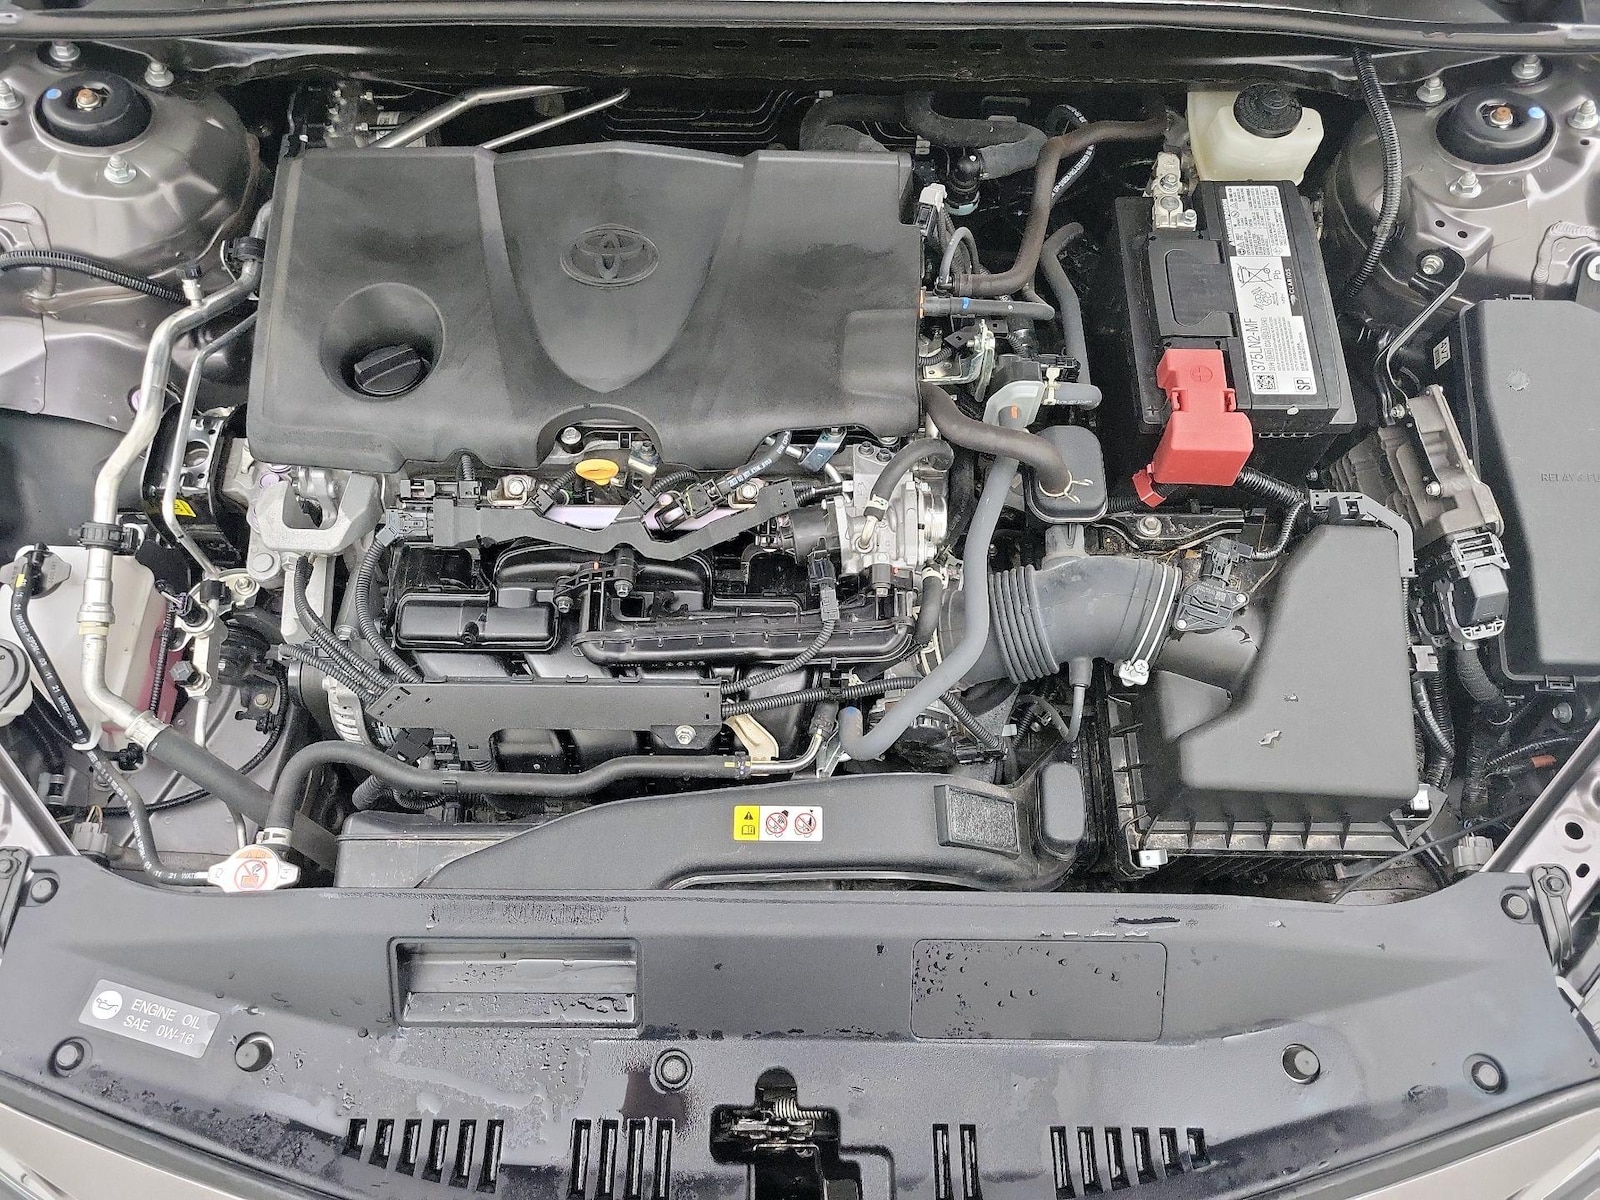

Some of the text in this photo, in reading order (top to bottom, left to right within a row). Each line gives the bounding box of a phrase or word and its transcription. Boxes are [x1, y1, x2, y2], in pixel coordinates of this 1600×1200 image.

[1273, 270, 1281, 280] Pb
[1284, 268, 1295, 294] CLARIOS
[1244, 318, 1266, 372] 375LN2-MF
[1296, 379, 1311, 391] SP
[15, 614, 29, 633] WATER
[132, 998, 201, 1030] ENGINE OIL
[123, 1014, 195, 1045] SAE 0W-16
